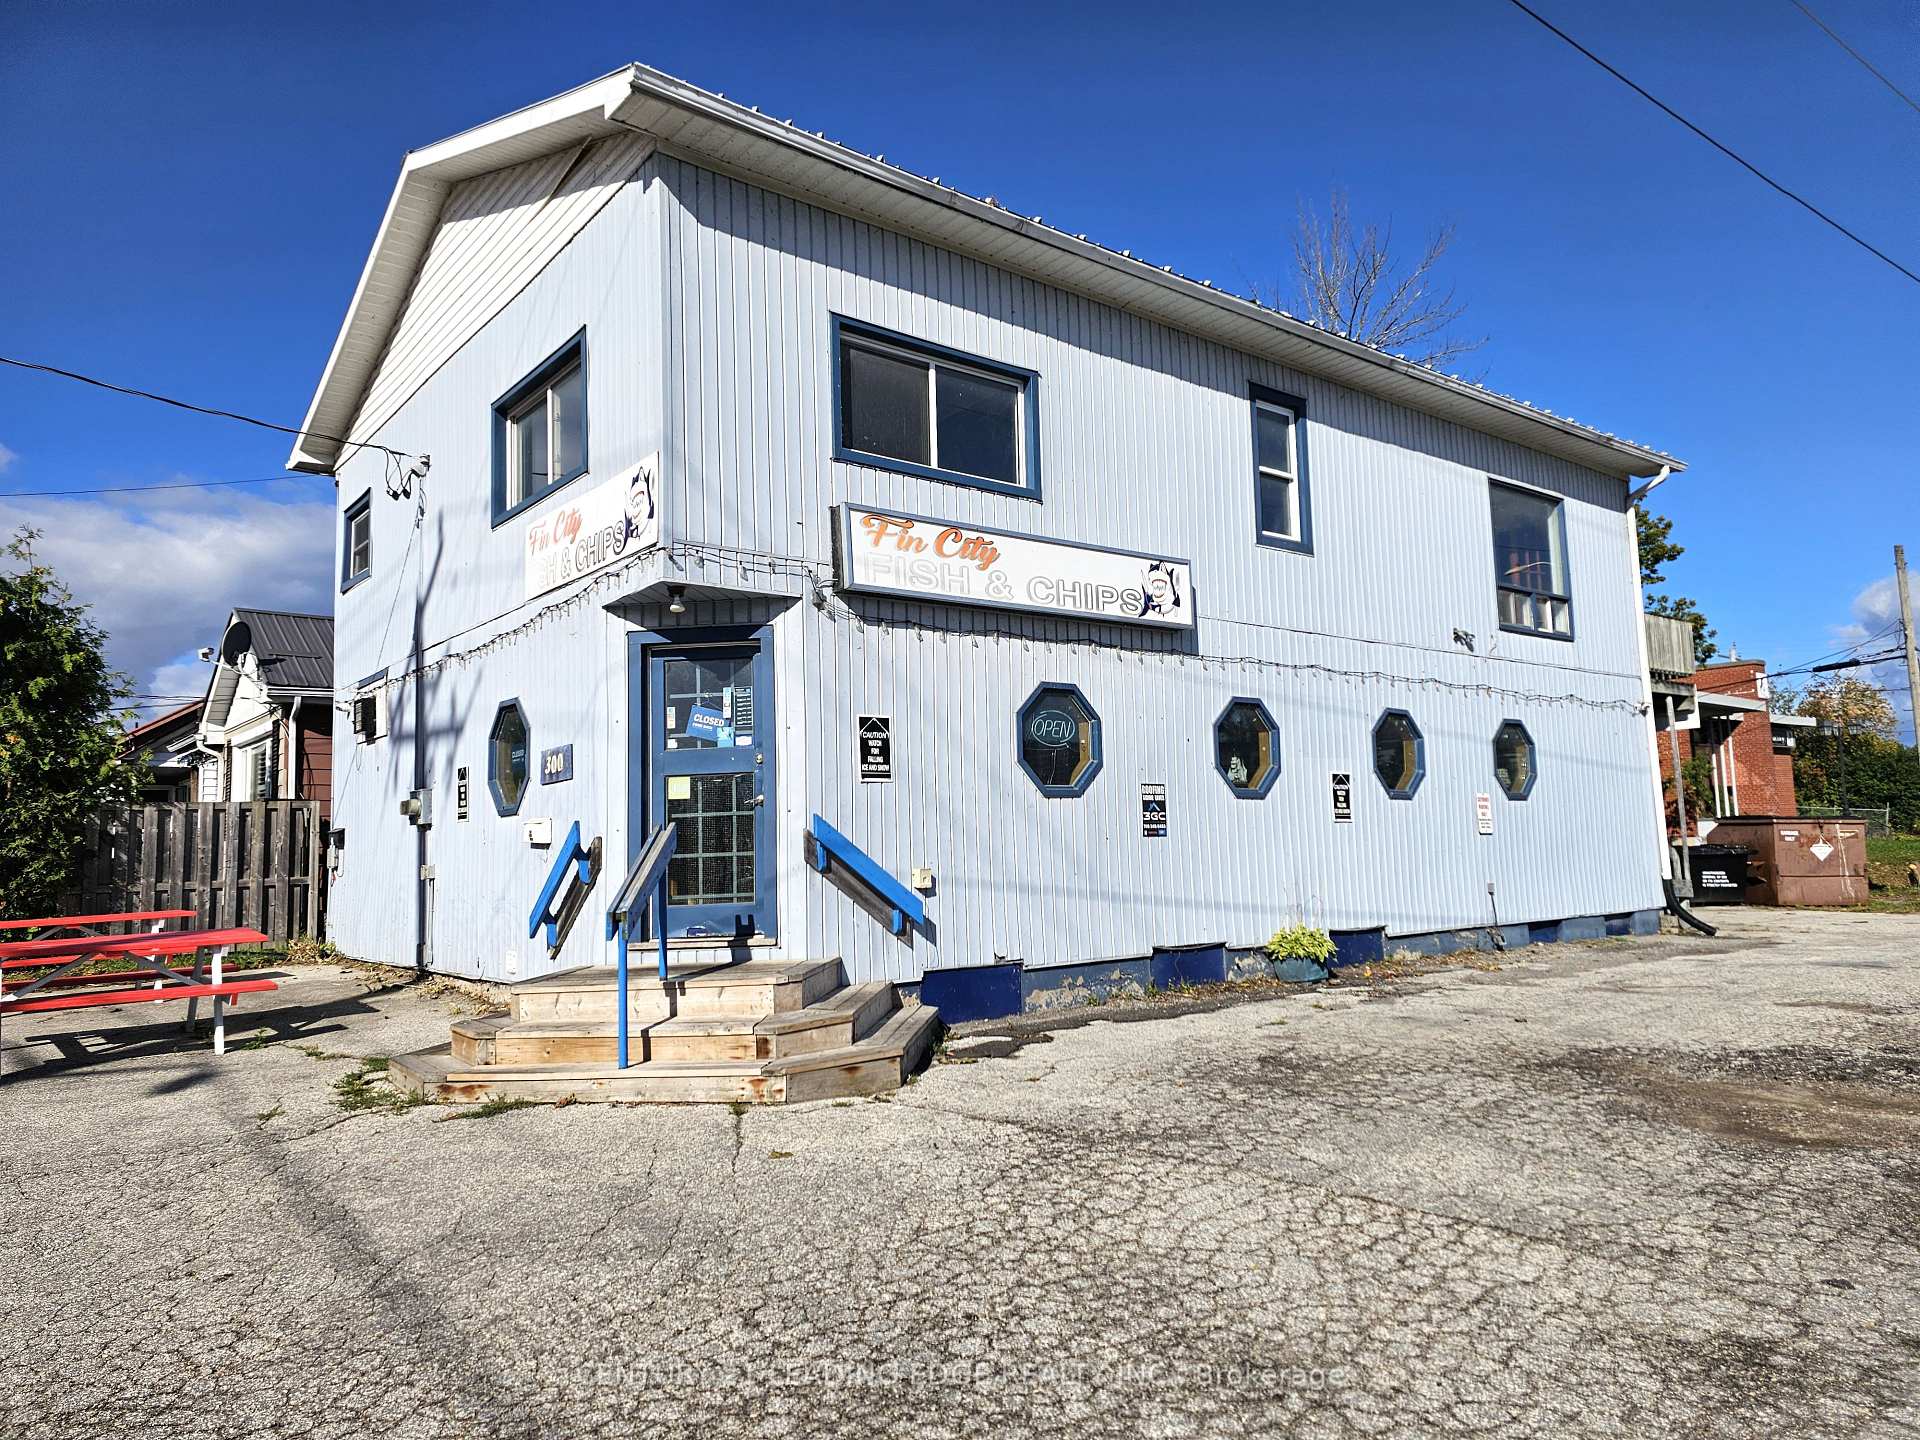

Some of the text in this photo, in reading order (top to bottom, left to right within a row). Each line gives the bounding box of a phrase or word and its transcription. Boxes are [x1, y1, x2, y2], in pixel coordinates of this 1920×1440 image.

[529, 507, 584, 556] Fin City
[860, 513, 1001, 572] Fin City
[575, 520, 625, 573] CHIPS
[864, 552, 1145, 617] FISH & CHIPS
[693, 713, 725, 727] CLOSED
[1034, 718, 1071, 738] OPEN
[862, 731, 887, 739] CAUTION
[544, 752, 564, 775] 300
[1143, 811, 1166, 821] 3GC
